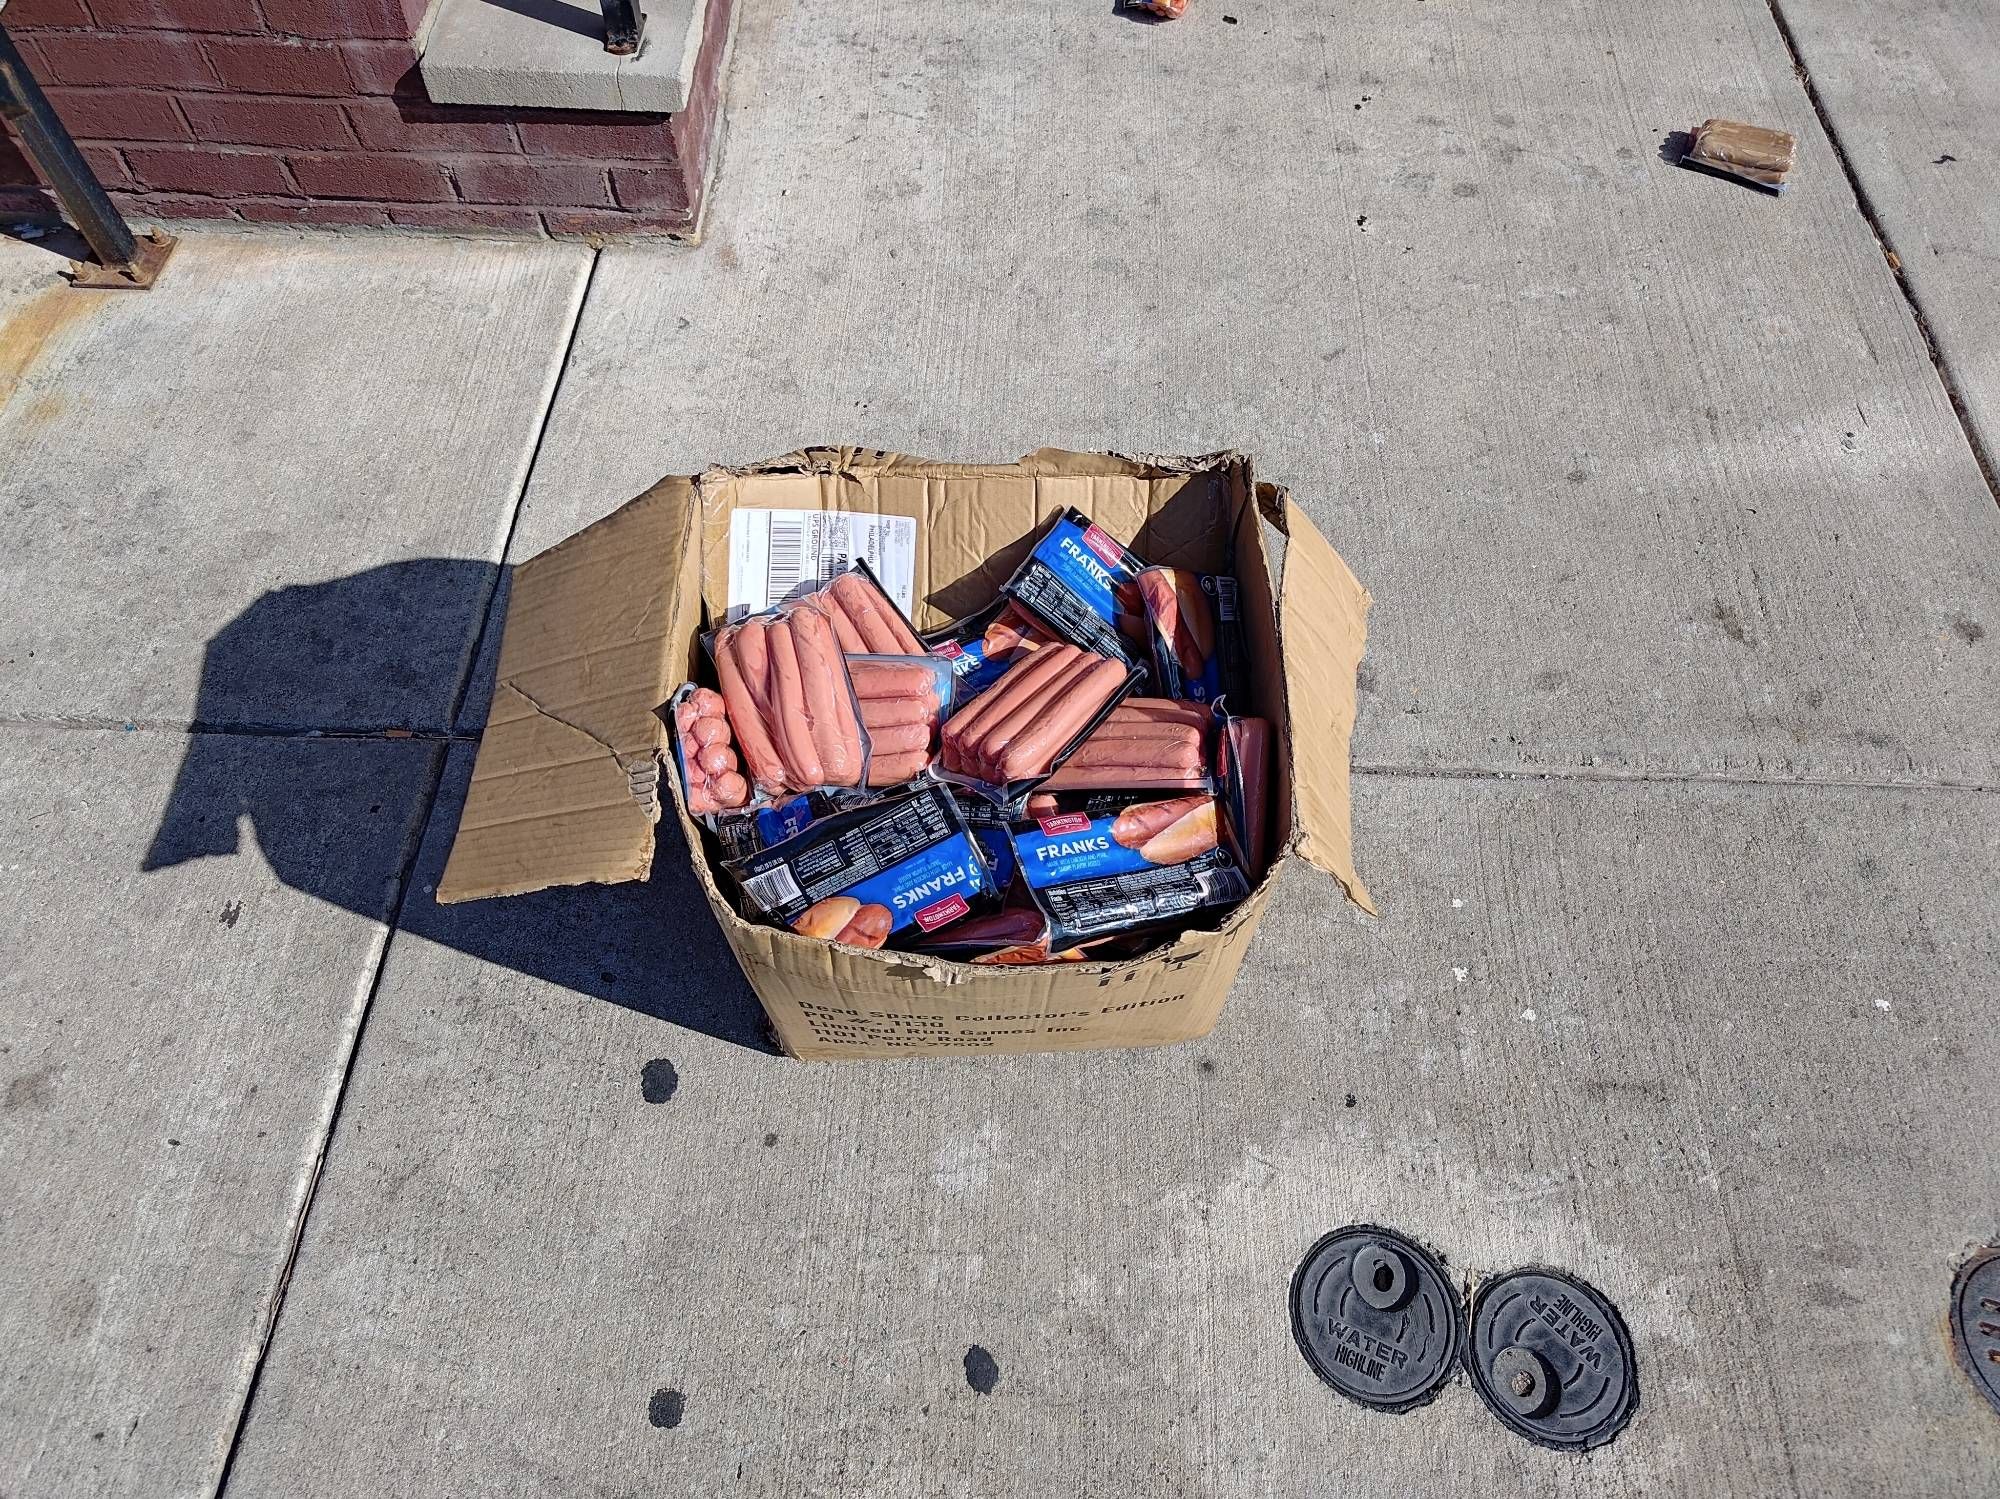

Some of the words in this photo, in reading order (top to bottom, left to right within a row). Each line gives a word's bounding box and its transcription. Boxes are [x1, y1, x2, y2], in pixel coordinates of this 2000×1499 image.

[810, 529, 819, 561] GROUND
[837, 553, 847, 565] PA
[1060, 537, 1113, 591] FRANKS
[1046, 815, 1083, 829] FARMINGTON
[1036, 835, 1110, 861] FRANKS
[892, 866, 966, 910] FRANKS
[923, 902, 960, 924] FARMINGTON
[798, 1001, 858, 1015] Dead
[869, 1011, 944, 1020] Space
[955, 1011, 1090, 1021] Collector's
[1101, 993, 1186, 1014] Edition
[803, 1011, 835, 1020] PO
[808, 1020, 895, 1034] Limited
[812, 1028, 857, 1038] 1101
[1552, 1293, 1605, 1343] HIGHLINE
[1328, 1317, 1409, 1370] WATER
[1529, 1295, 1603, 1371] WATER
[1334, 1343, 1389, 1383] HIGHLINE
